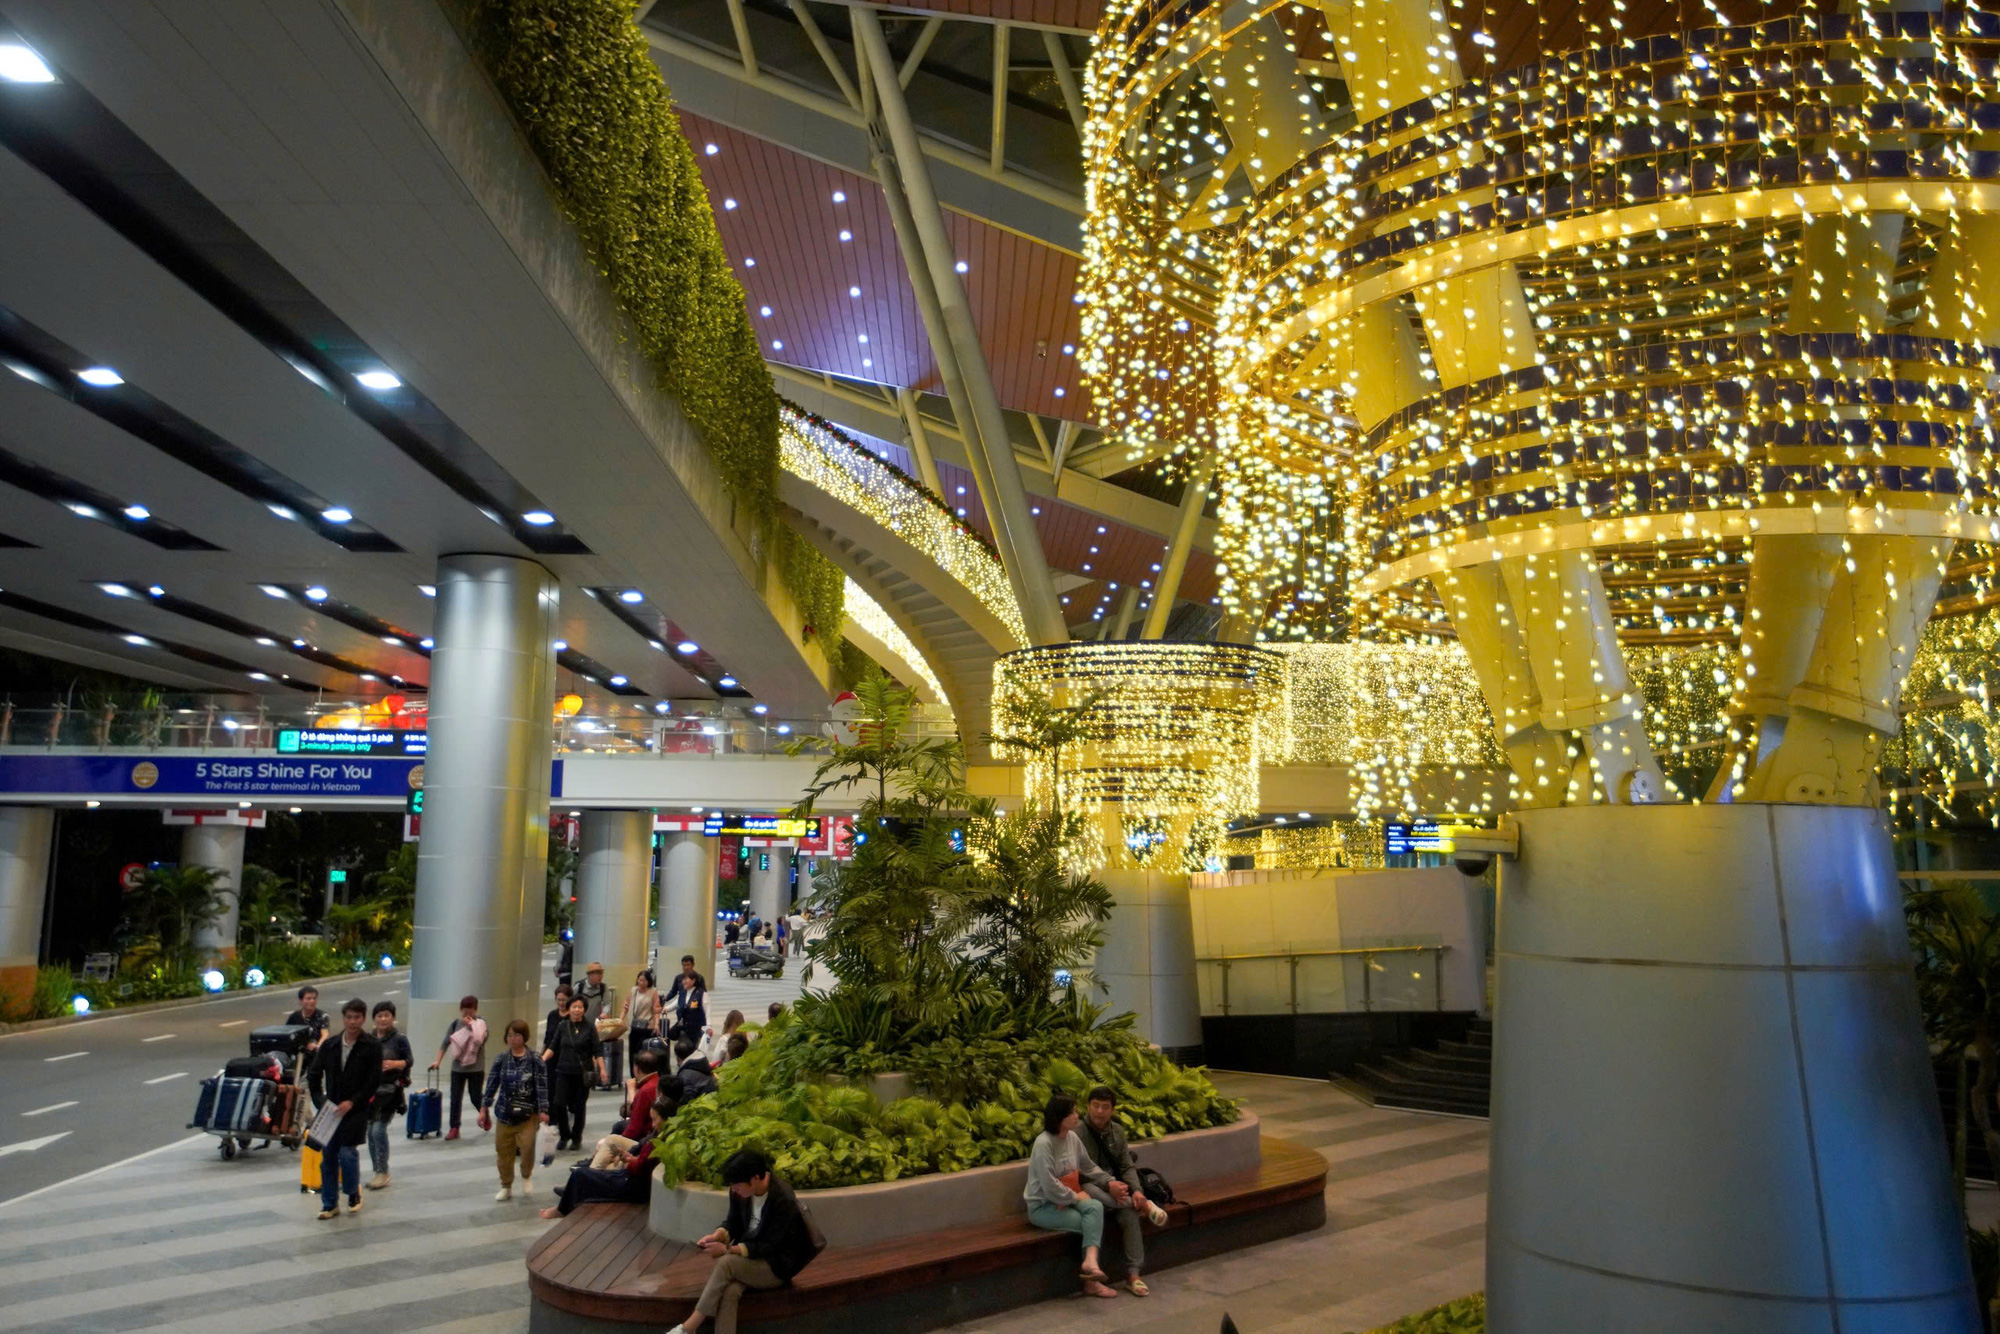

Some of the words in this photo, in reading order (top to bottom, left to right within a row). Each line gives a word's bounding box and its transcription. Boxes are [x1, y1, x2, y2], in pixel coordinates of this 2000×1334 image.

[331, 743, 356, 751] parking
[357, 743, 372, 751] only
[196, 763, 207, 777] 5
[211, 763, 253, 777] Stars
[257, 763, 305, 778] Shine
[310, 764, 338, 778] For
[341, 764, 372, 779] You
[205, 781, 222, 790] The
[223, 781, 242, 790] first
[243, 781, 250, 790] 5
[250, 782, 270, 790] star
[270, 782, 310, 790] terminal
[310, 781, 320, 790] in
[322, 782, 361, 791] Vietnam
[741, 846, 749, 859] 3
